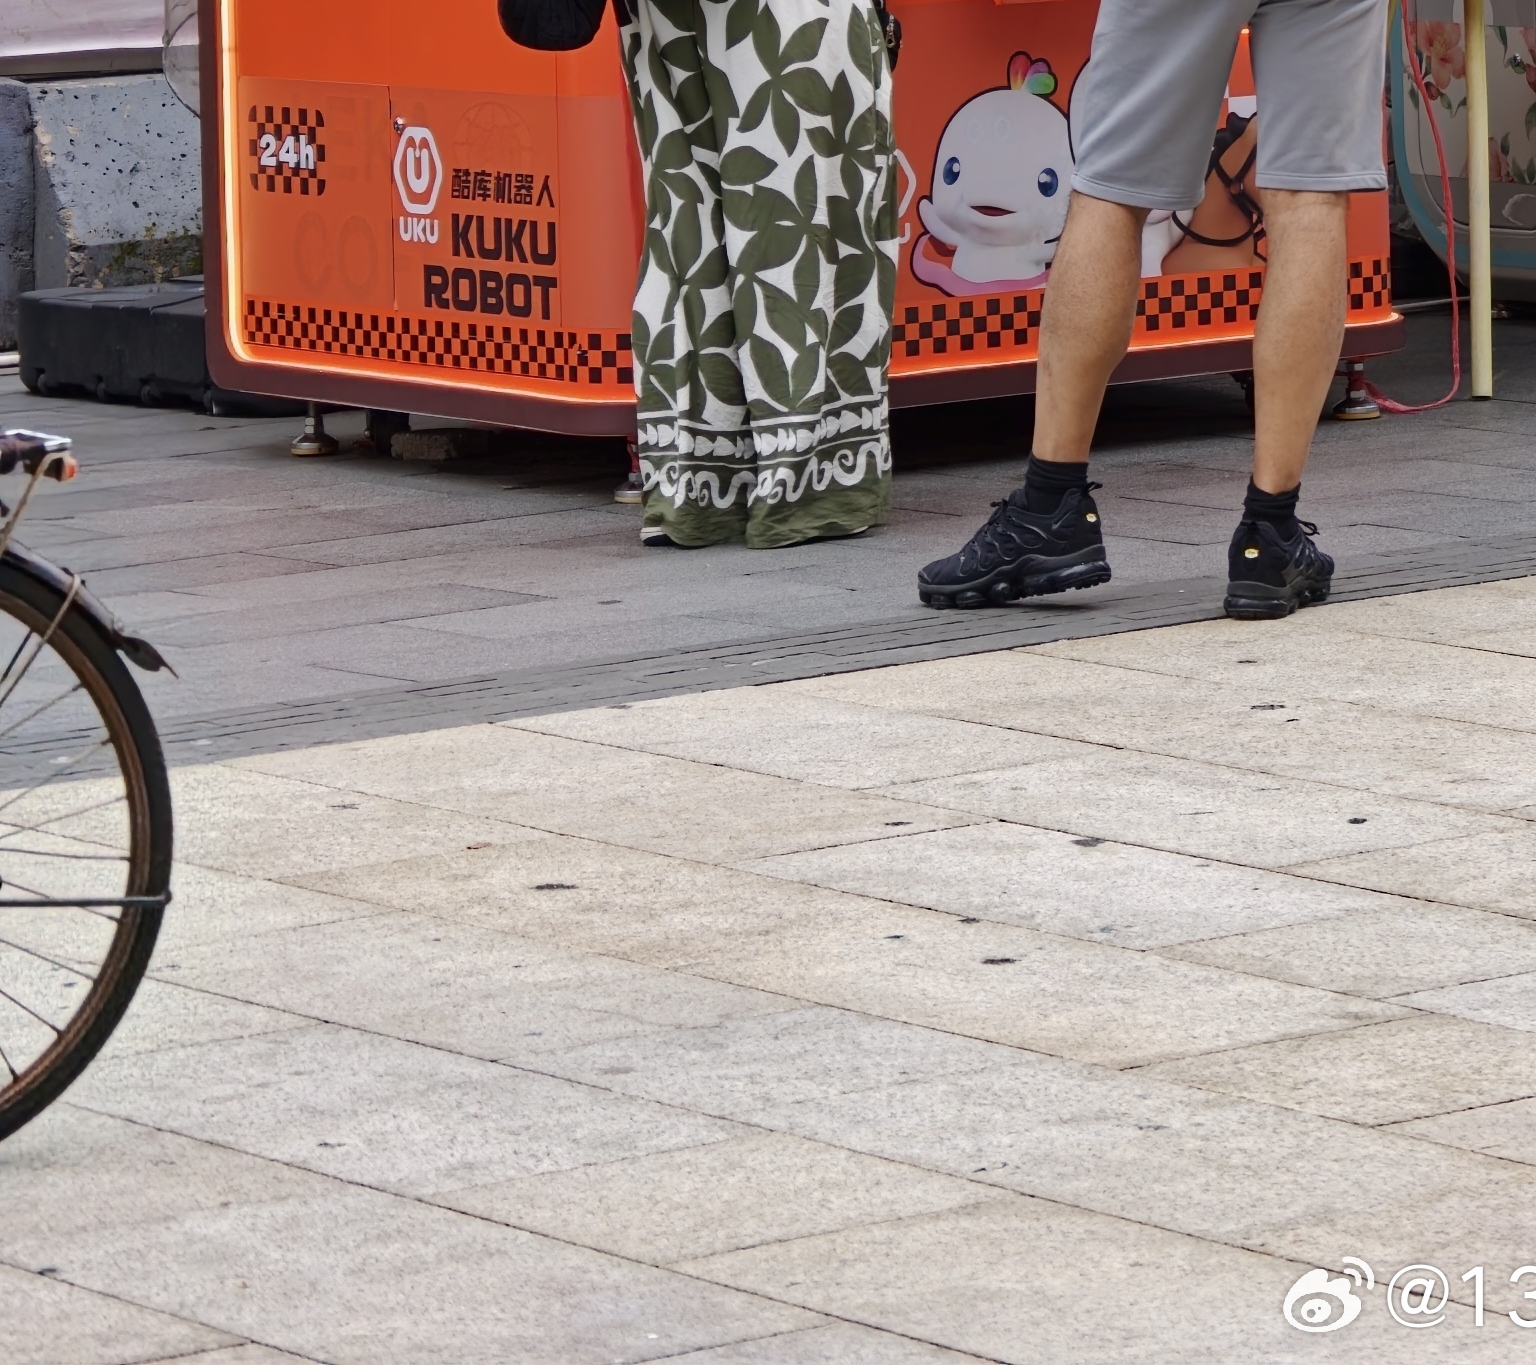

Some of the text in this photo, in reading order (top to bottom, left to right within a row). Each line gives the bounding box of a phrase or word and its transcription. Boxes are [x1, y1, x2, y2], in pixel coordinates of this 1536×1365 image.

[259, 134, 315, 170] 24h
[451, 168, 556, 209] 酷库机器人
[400, 216, 439, 244] UKU
[451, 213, 557, 266] KUKU
[423, 264, 558, 321] ROBOT
